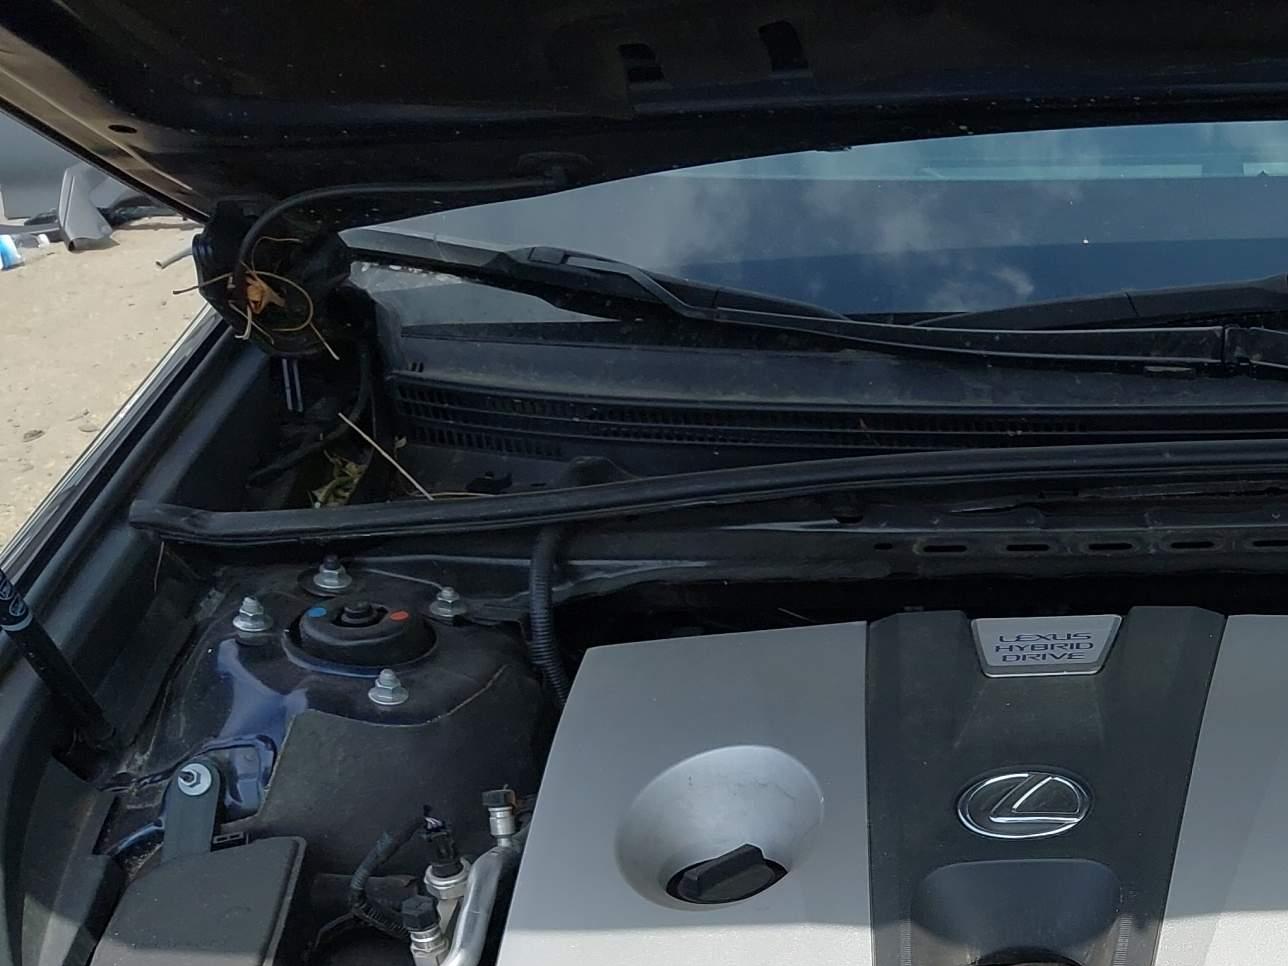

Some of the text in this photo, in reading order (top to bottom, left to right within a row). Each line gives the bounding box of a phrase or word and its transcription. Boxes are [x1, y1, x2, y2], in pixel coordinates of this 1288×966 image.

[1000, 633, 1092, 642] LEXUS
[995, 642, 1094, 652] HYBRID
[1002, 652, 1085, 662] DRIVE
